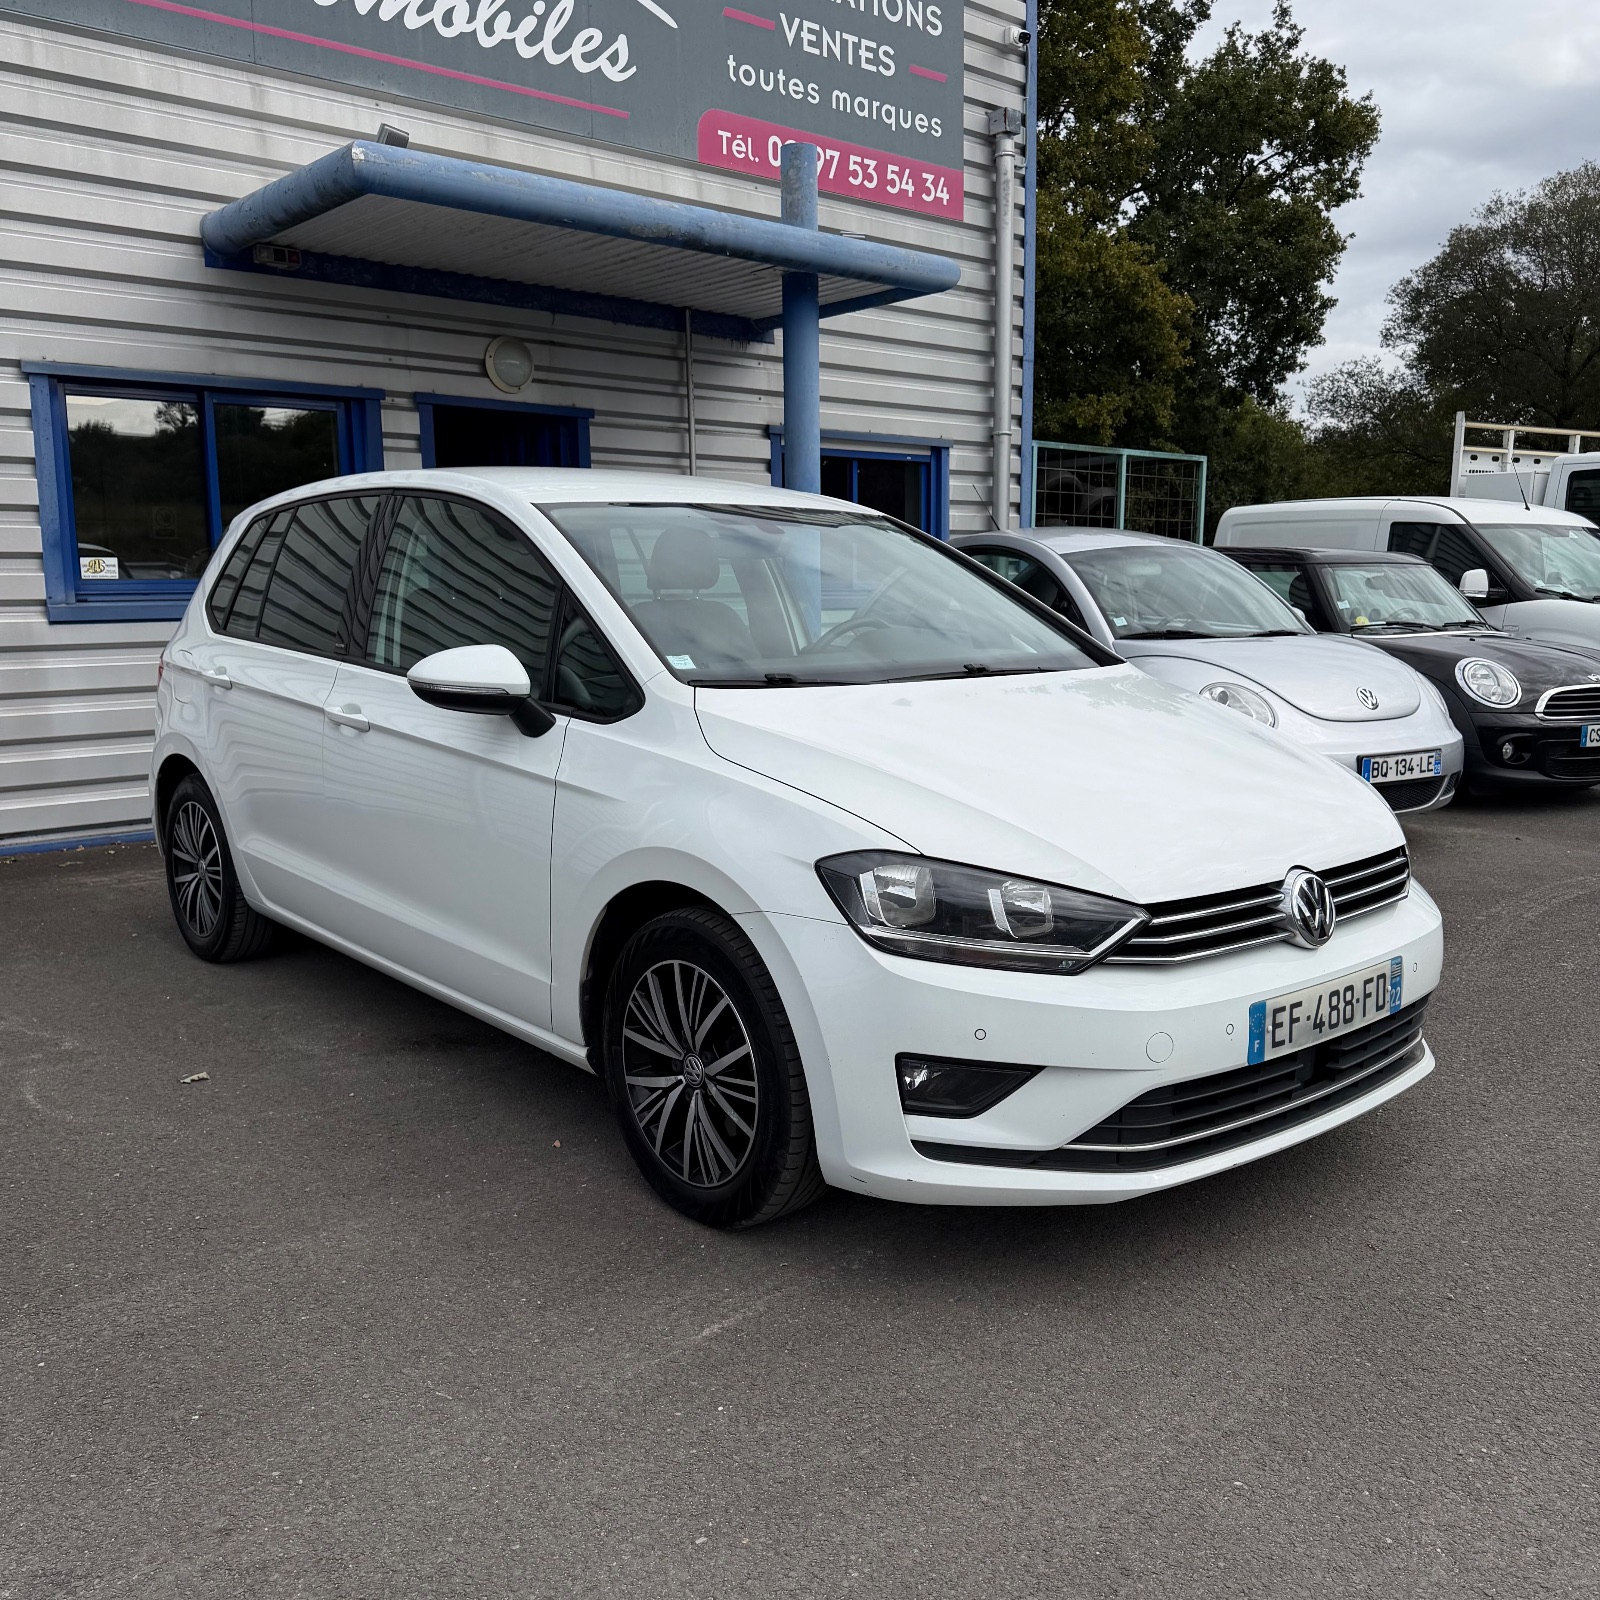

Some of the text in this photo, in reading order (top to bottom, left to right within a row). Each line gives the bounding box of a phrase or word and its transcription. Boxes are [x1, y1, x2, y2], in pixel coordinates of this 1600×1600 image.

[779, 12, 896, 77] VENTES
[727, 55, 943, 138] toutes marques
[717, 130, 760, 163] Tél.
[767, 135, 796, 168] 0
[848, 155, 878, 189] 53
[886, 163, 915, 198] 54
[921, 172, 950, 206] 34
[1254, 1040, 1260, 1053] F
[1390, 986, 1401, 1008] 22
